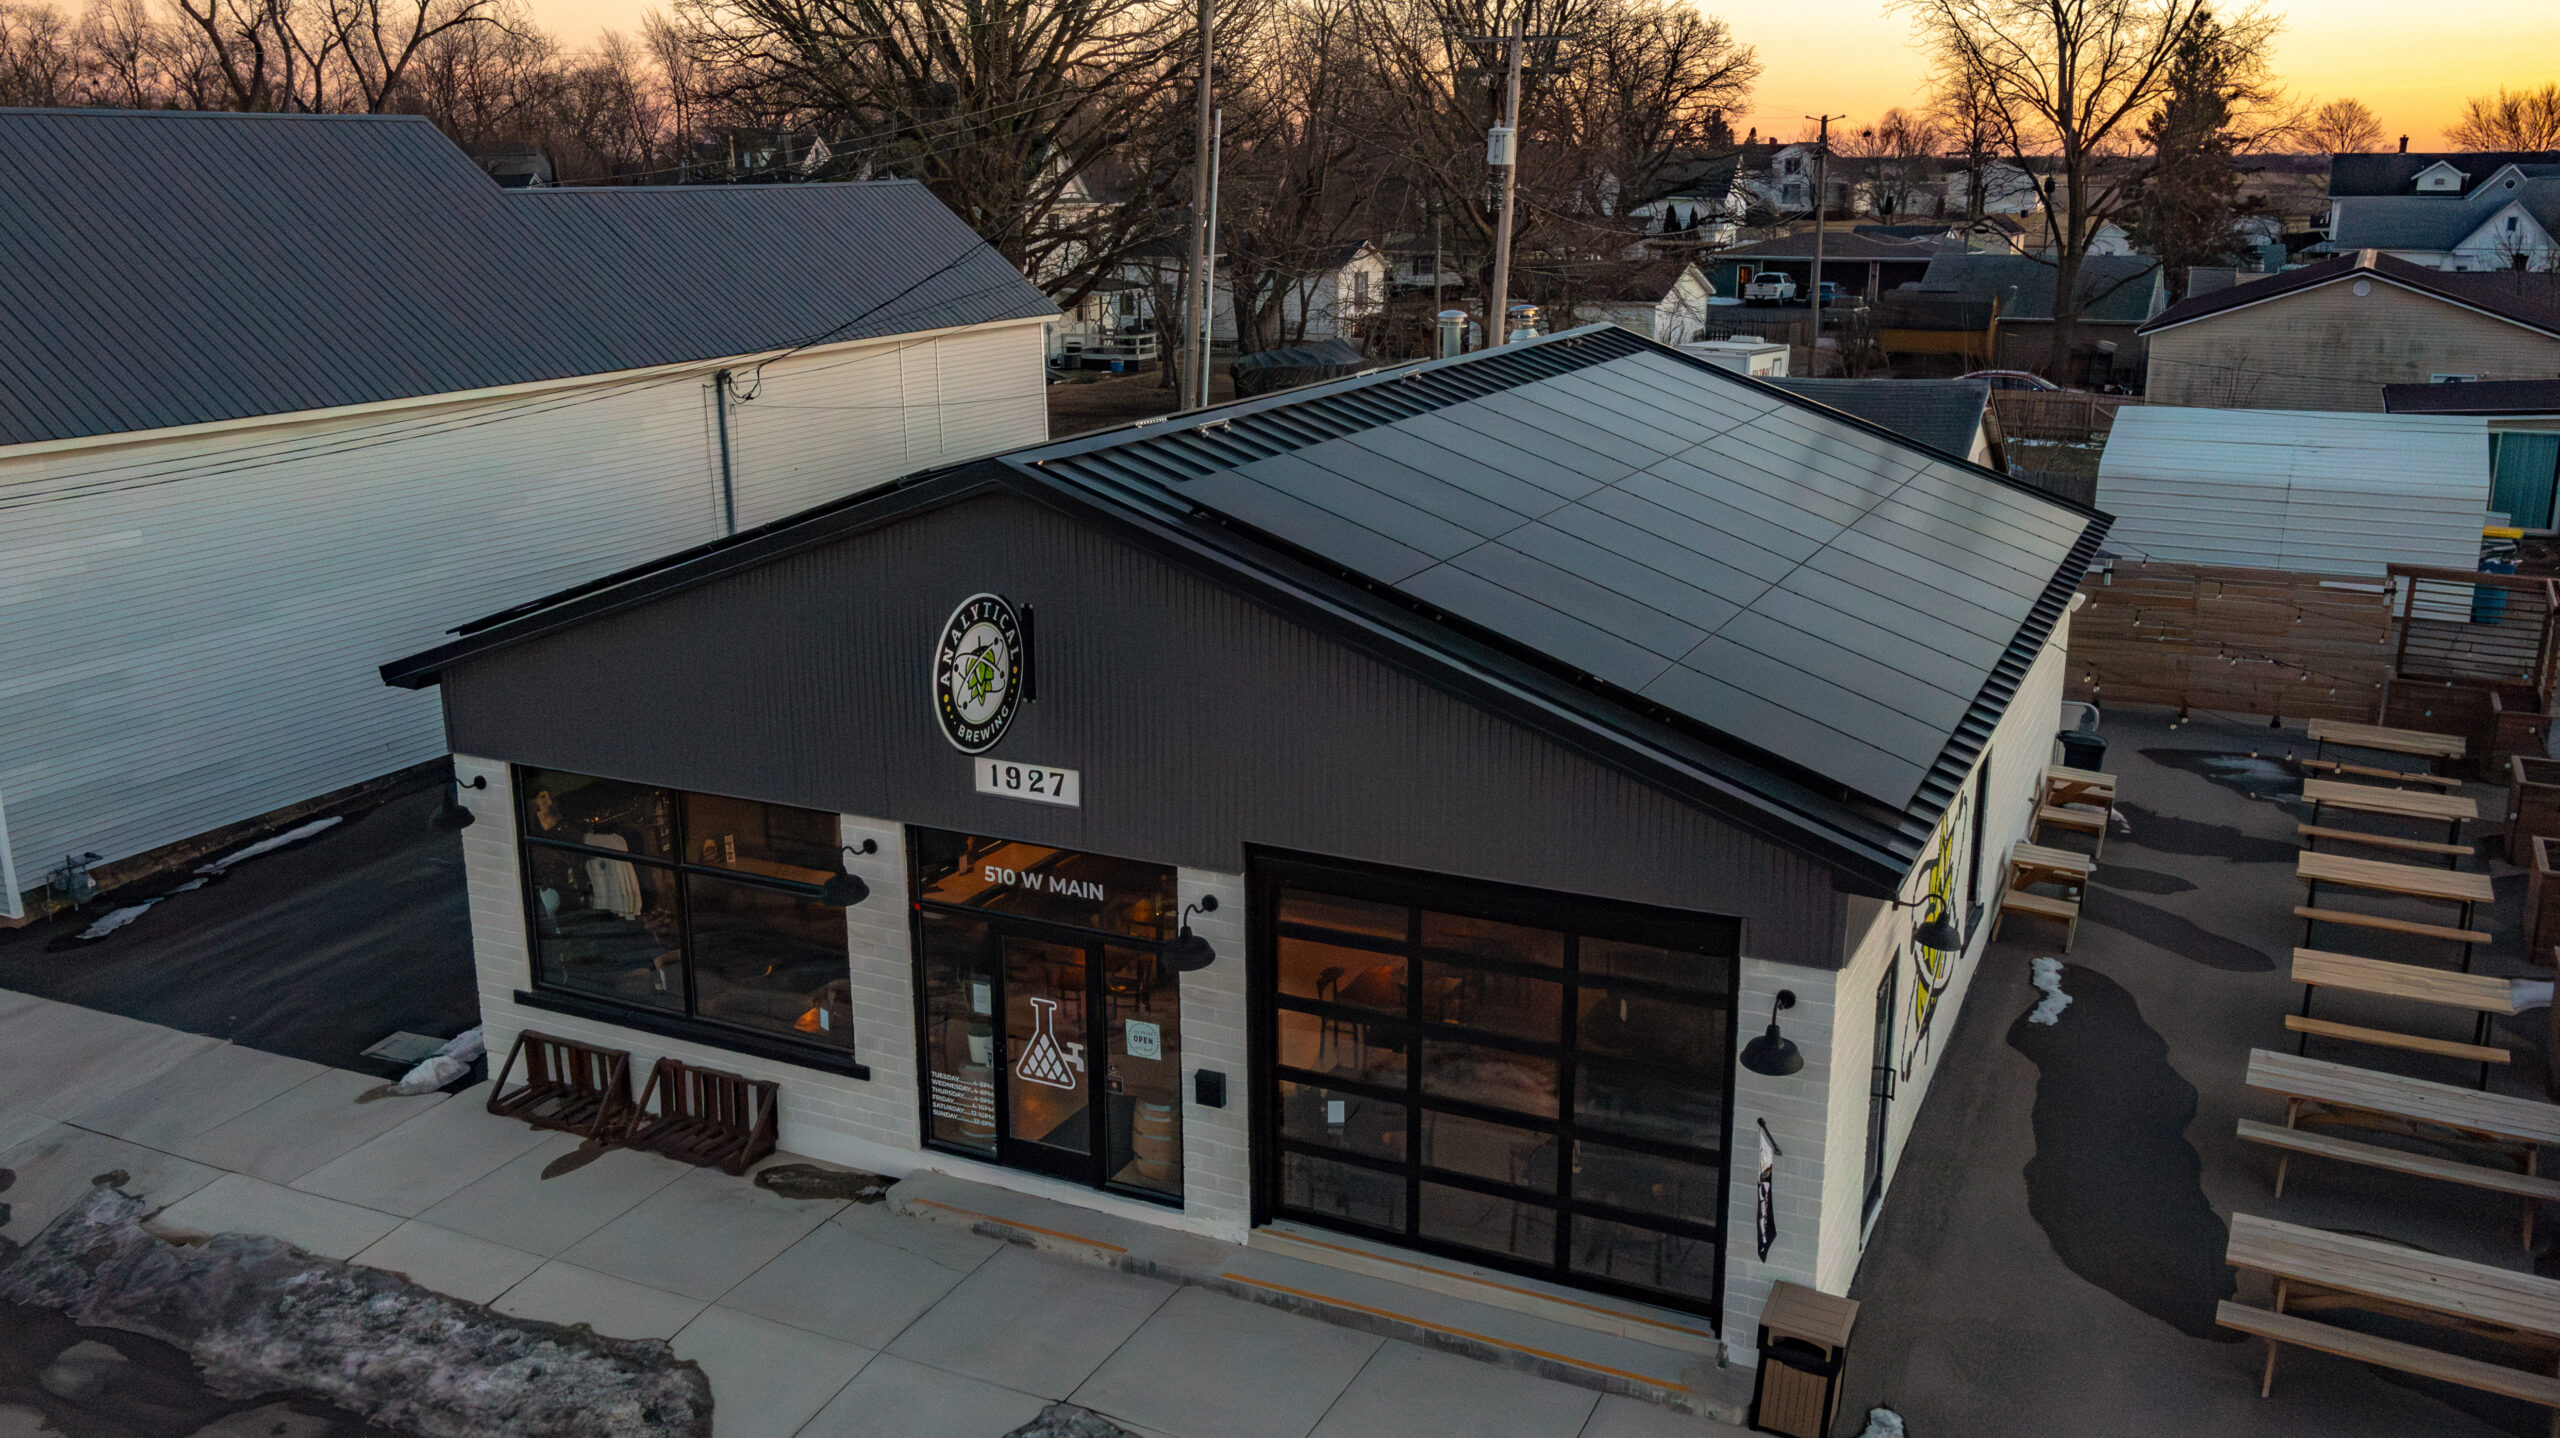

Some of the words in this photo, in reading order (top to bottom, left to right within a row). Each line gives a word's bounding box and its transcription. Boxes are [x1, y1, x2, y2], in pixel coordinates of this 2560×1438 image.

[940, 601, 1020, 687] ANALYTICAL
[957, 705, 1010, 743] BREWING
[990, 763, 1065, 798] 1927
[984, 865, 1016, 885] 510
[1021, 871, 1043, 891] W
[1049, 875, 1104, 901] MAIN
[1133, 1034, 1154, 1046] OPEN
